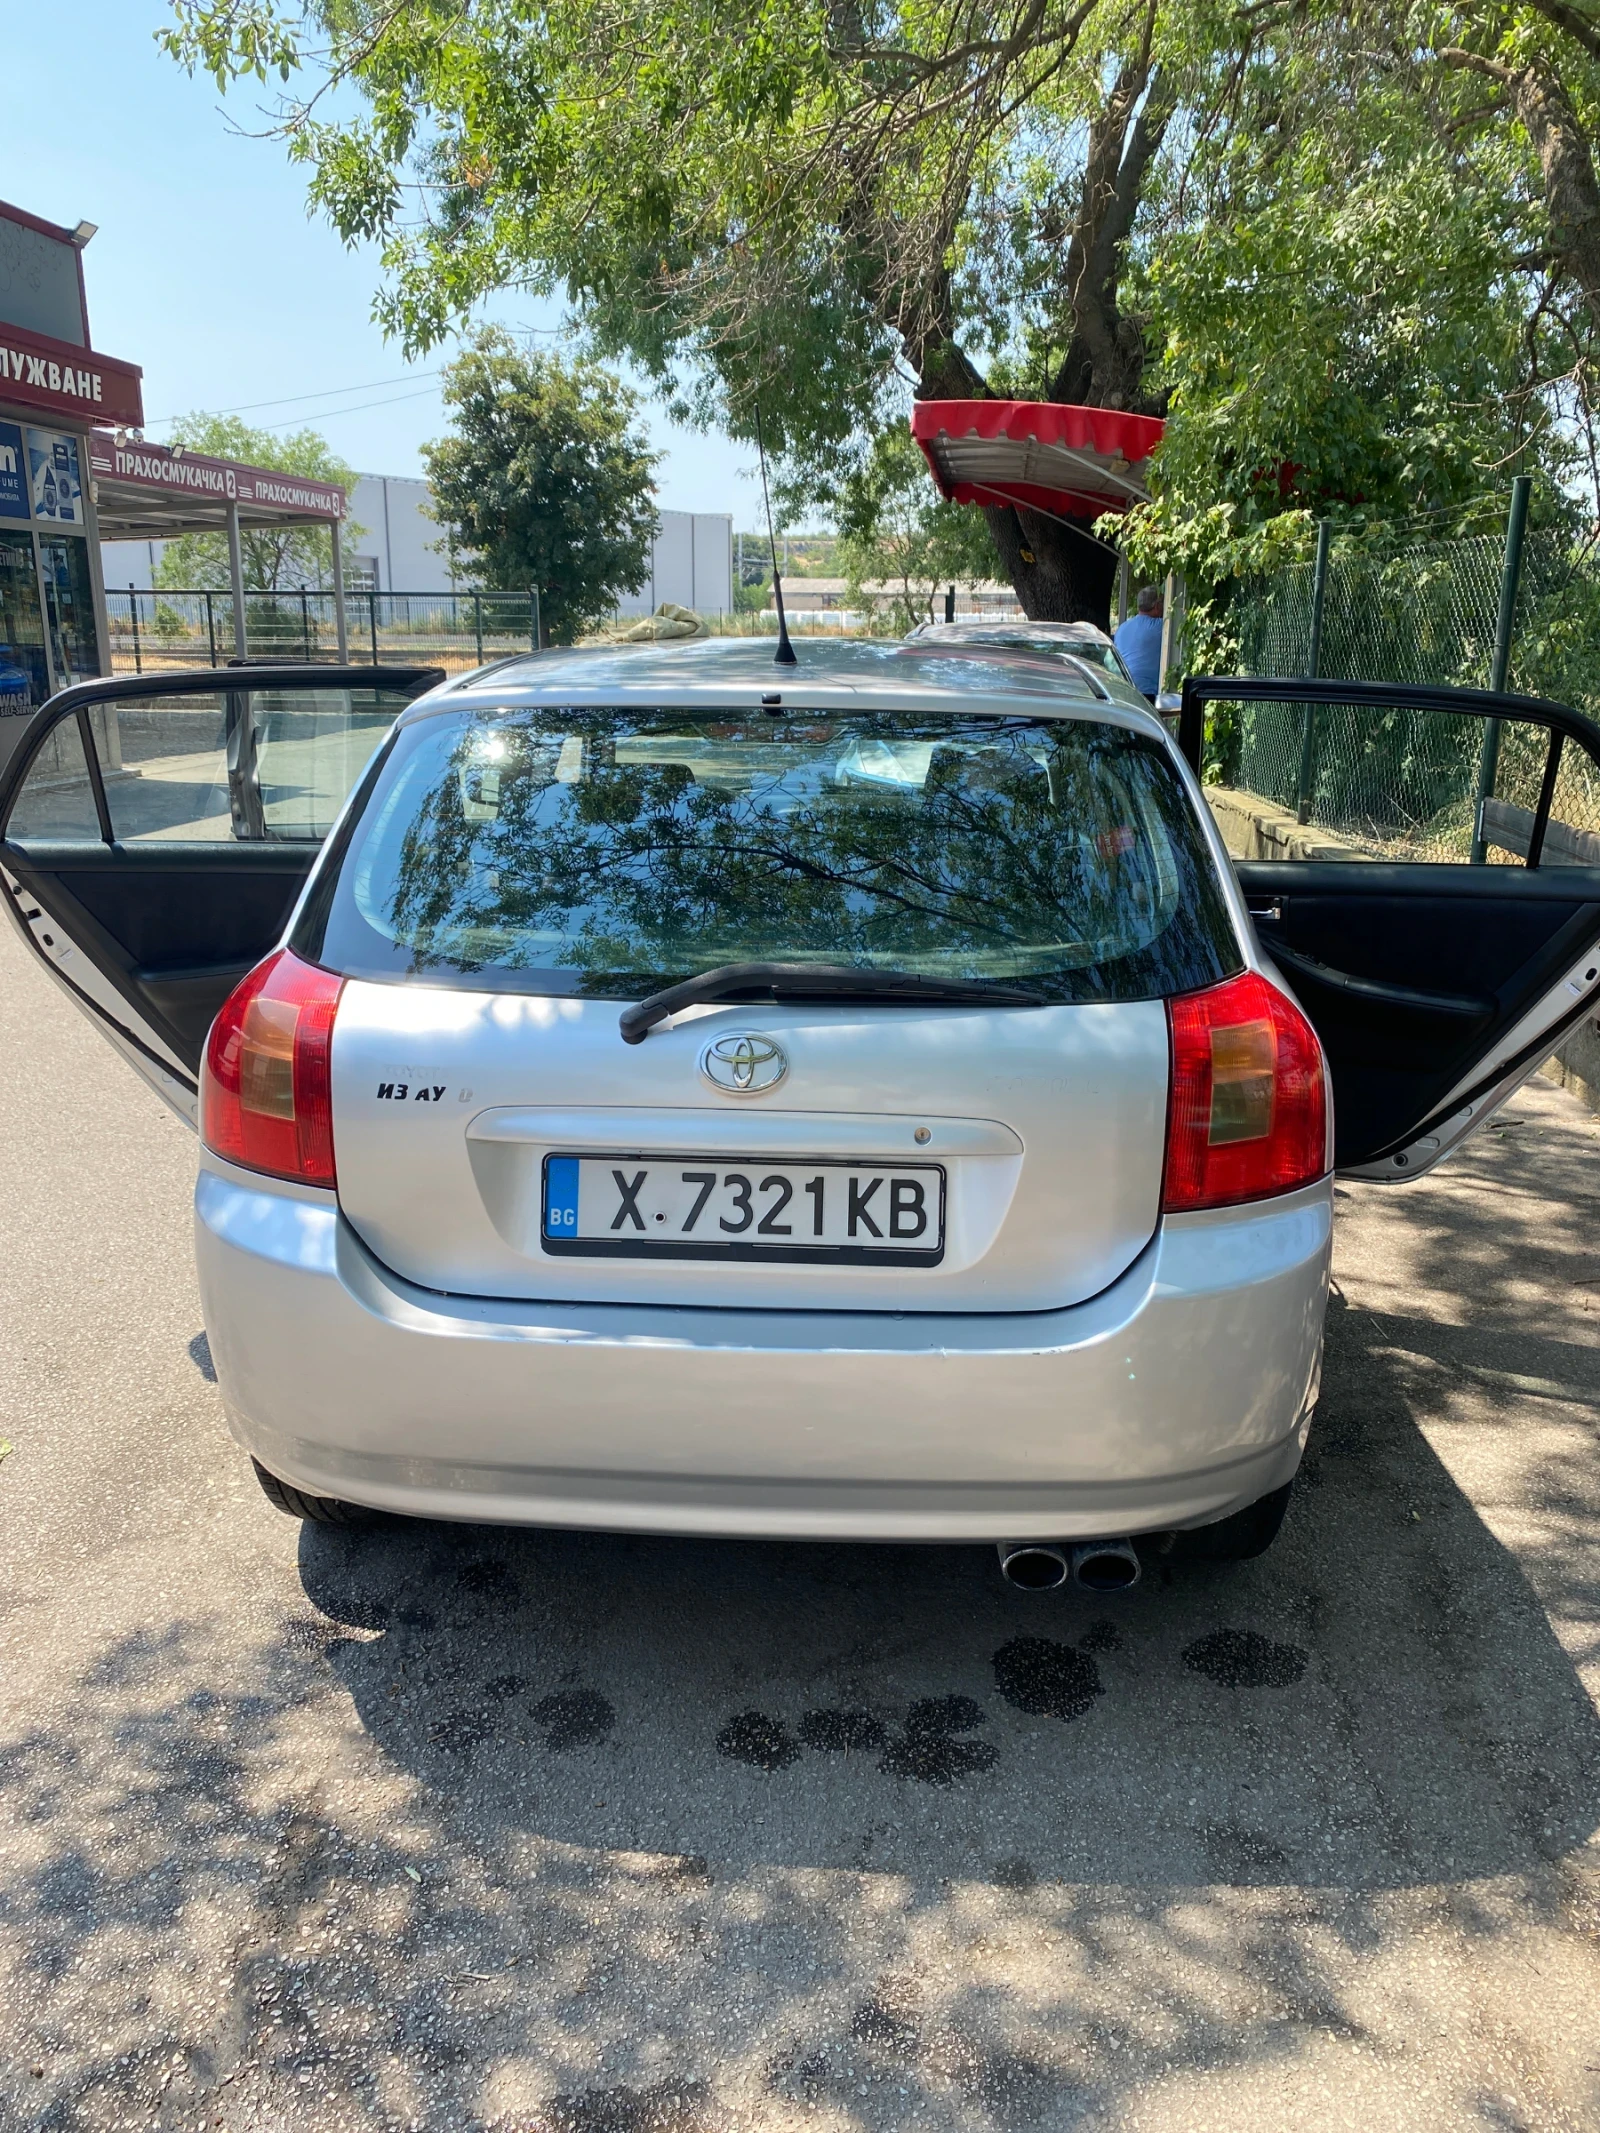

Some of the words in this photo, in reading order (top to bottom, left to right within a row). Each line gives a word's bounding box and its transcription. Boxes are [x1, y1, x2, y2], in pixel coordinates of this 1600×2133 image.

[115, 451, 225, 492] ПРАХОСМУКАЧКА
[227, 473, 235, 495] 2
[0, 477, 19, 489] UME
[255, 481, 332, 511] ПРАХОСМУКАЧКА
[333, 495, 339, 514] 3
[0, 692, 31, 707] WASH
[377, 1083, 409, 1100] ИЗ
[610, 1170, 648, 1230] X
[681, 1172, 826, 1236] 7321
[847, 1177, 928, 1239] KB
[550, 1208, 575, 1226] BG
